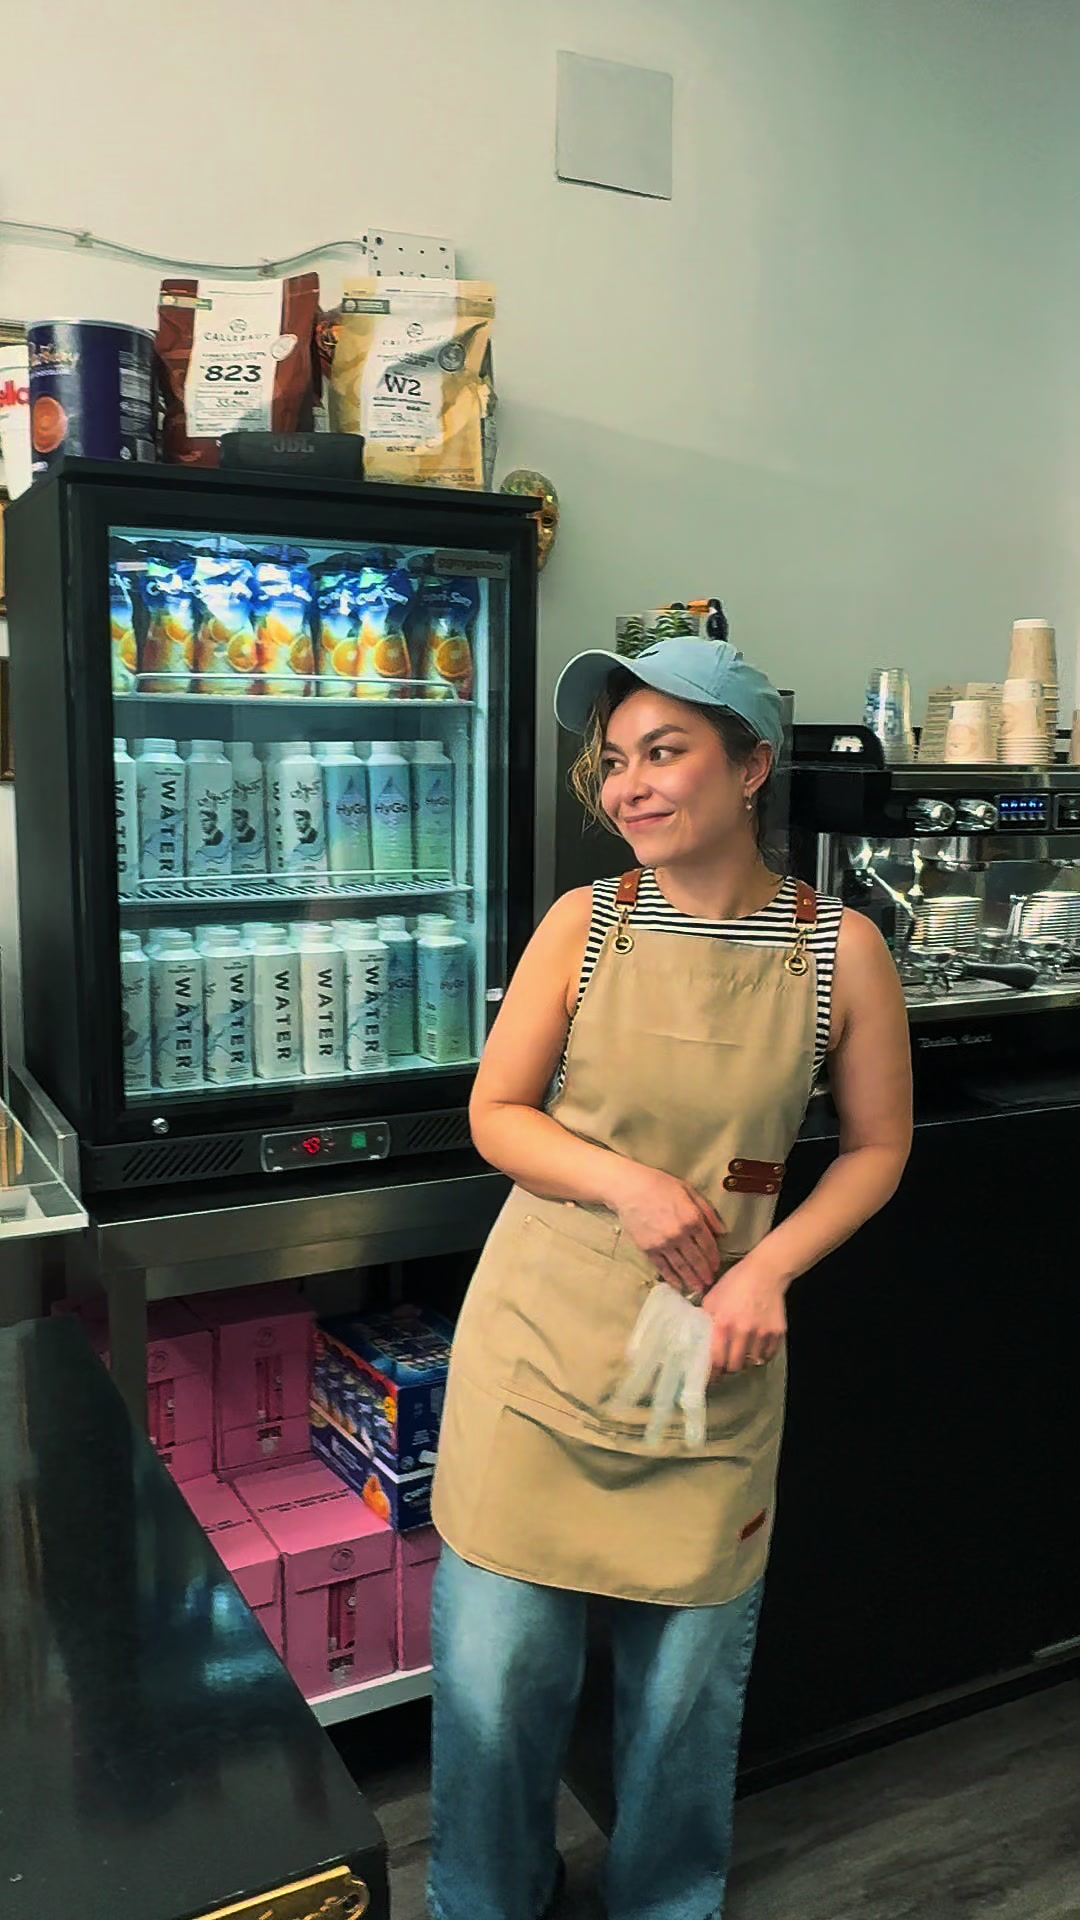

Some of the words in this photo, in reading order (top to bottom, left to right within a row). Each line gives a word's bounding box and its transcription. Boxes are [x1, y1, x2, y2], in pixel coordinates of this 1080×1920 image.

[0, 380, 30, 407] lla
[205, 365, 262, 383] 823
[384, 373, 421, 397] W2
[159, 779, 177, 871] WATER
[375, 801, 409, 816] HyGo
[175, 976, 193, 1068] WATER
[230, 972, 246, 1063] WATER
[274, 969, 292, 1060] WATER
[317, 968, 335, 1057] WATER
[364, 965, 381, 1053] WATER
